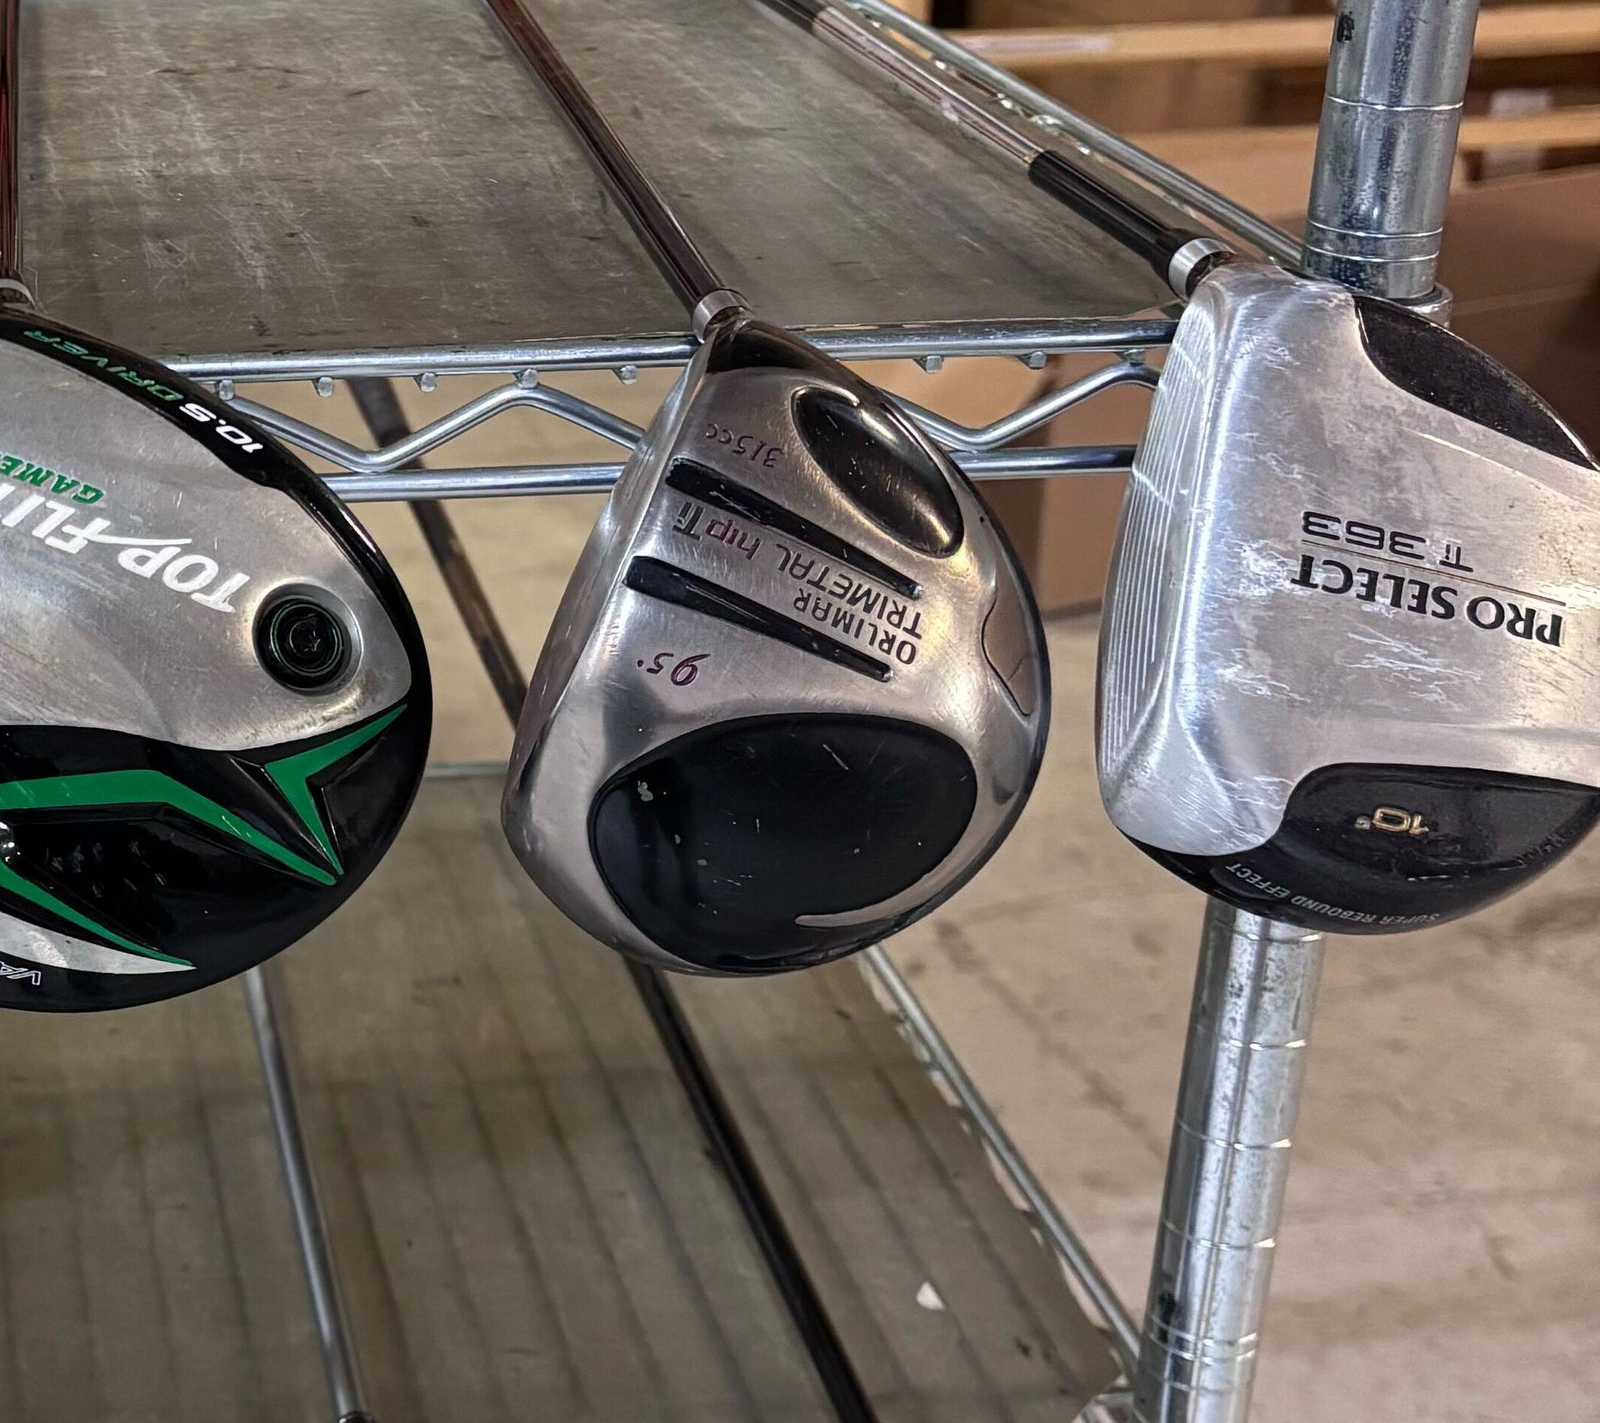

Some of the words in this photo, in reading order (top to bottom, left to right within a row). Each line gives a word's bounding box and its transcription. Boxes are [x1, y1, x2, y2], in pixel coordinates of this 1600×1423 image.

[24, 329, 182, 405] DRIVER
[180, 401, 265, 455] 10.5
[705, 422, 786, 469] 315cc
[1301, 510, 1426, 560] 363
[774, 541, 925, 639] TRIMETAL
[1291, 554, 1460, 621] SELECT
[792, 591, 919, 666] ORLIMAR
[1466, 595, 1562, 647] PRO
[1225, 860, 1290, 899] EFFECT
[1291, 894, 1377, 924] REBOUND
[1380, 911, 1440, 926] SUPER
